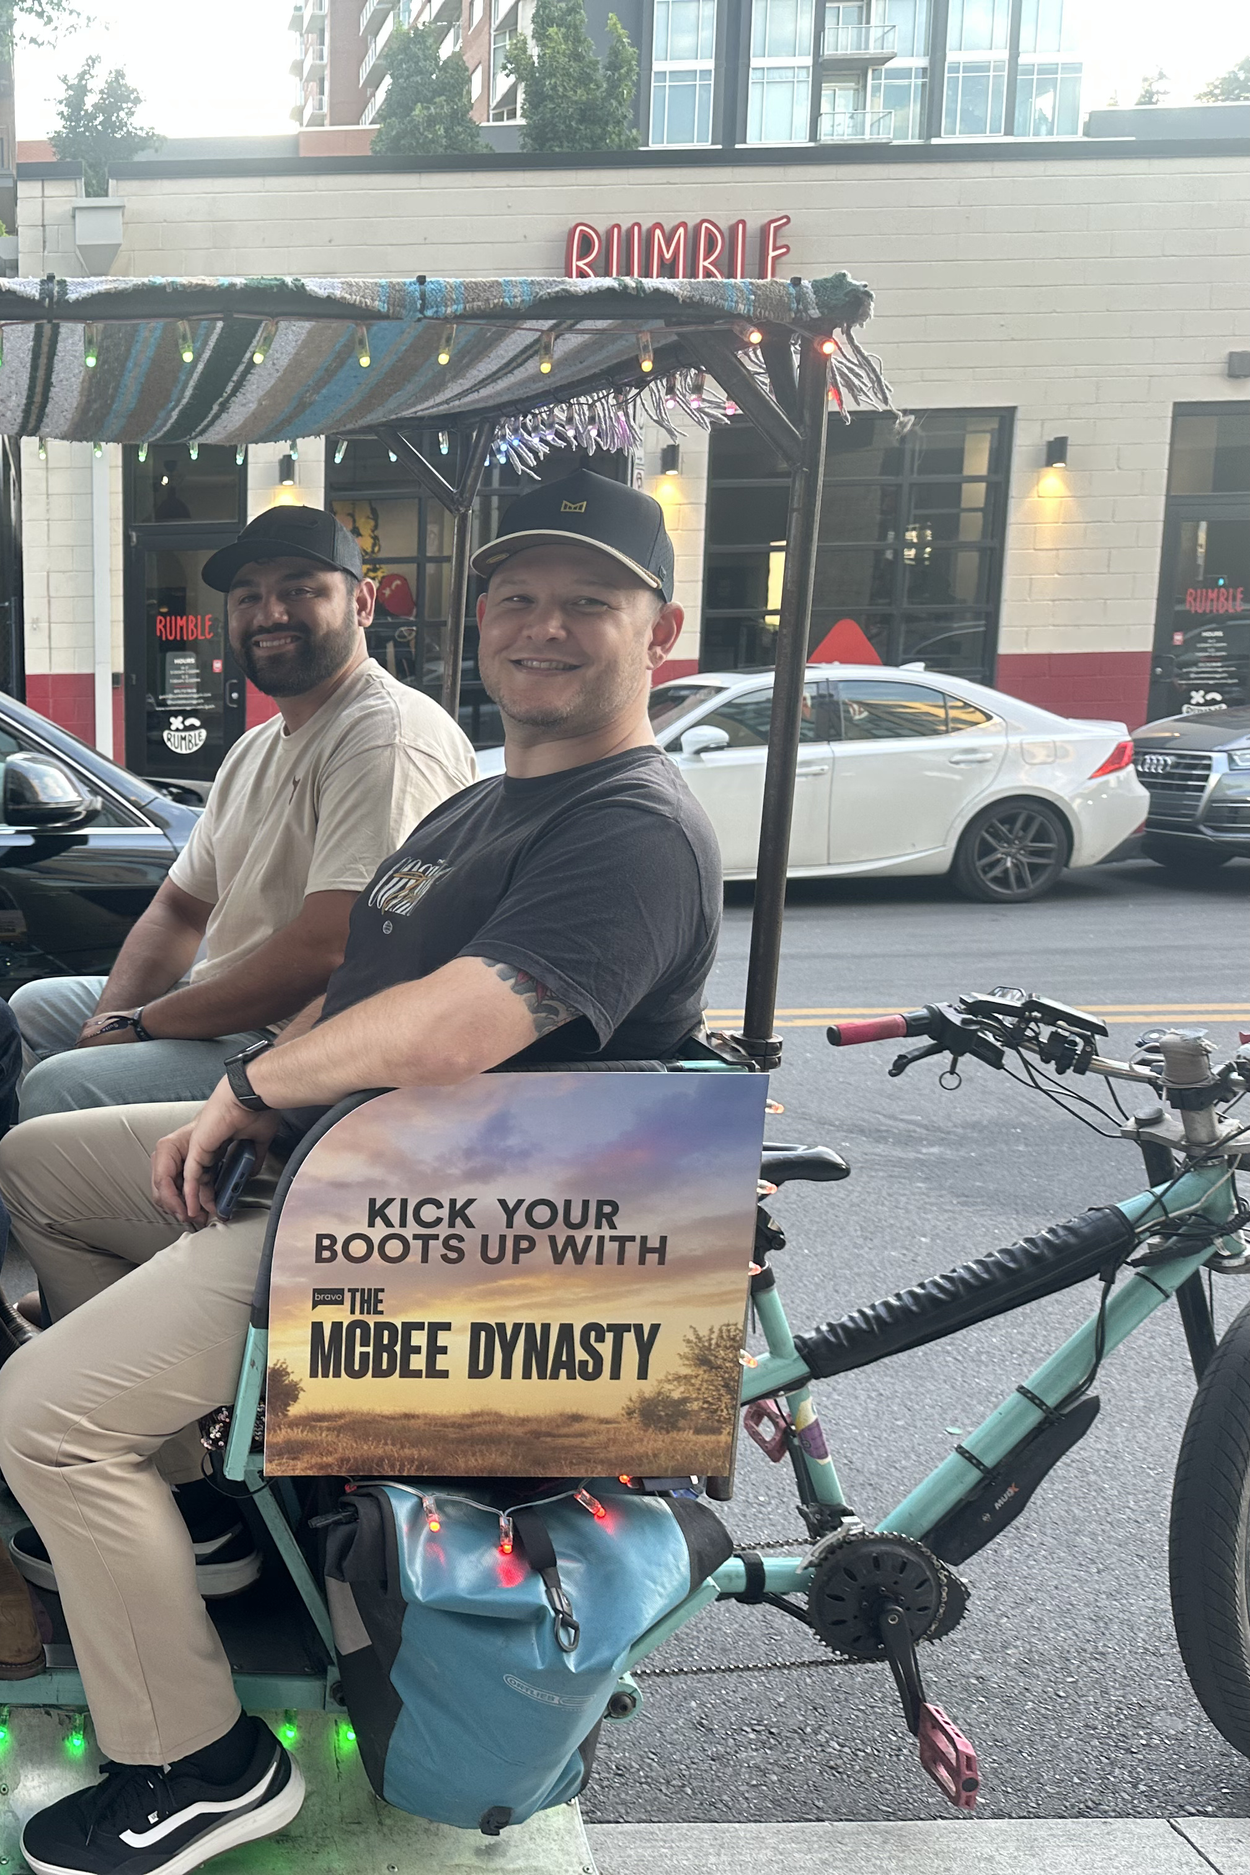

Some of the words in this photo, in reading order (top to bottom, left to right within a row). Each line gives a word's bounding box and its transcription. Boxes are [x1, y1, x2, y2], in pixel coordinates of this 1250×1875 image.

[1185, 586, 1245, 614] RUMBLE
[156, 614, 214, 641] RUMBLE
[166, 730, 203, 752] RUMBLE
[366, 1197, 477, 1229] KICK
[496, 1199, 620, 1231] YOUR
[314, 1232, 466, 1265] BOOTS
[479, 1234, 538, 1266] UP
[548, 1235, 668, 1266] WITH
[314, 1292, 343, 1301] bravo
[347, 1287, 385, 1315] THE
[308, 1318, 452, 1380] MCBEE
[467, 1321, 661, 1382] DYNASTY
